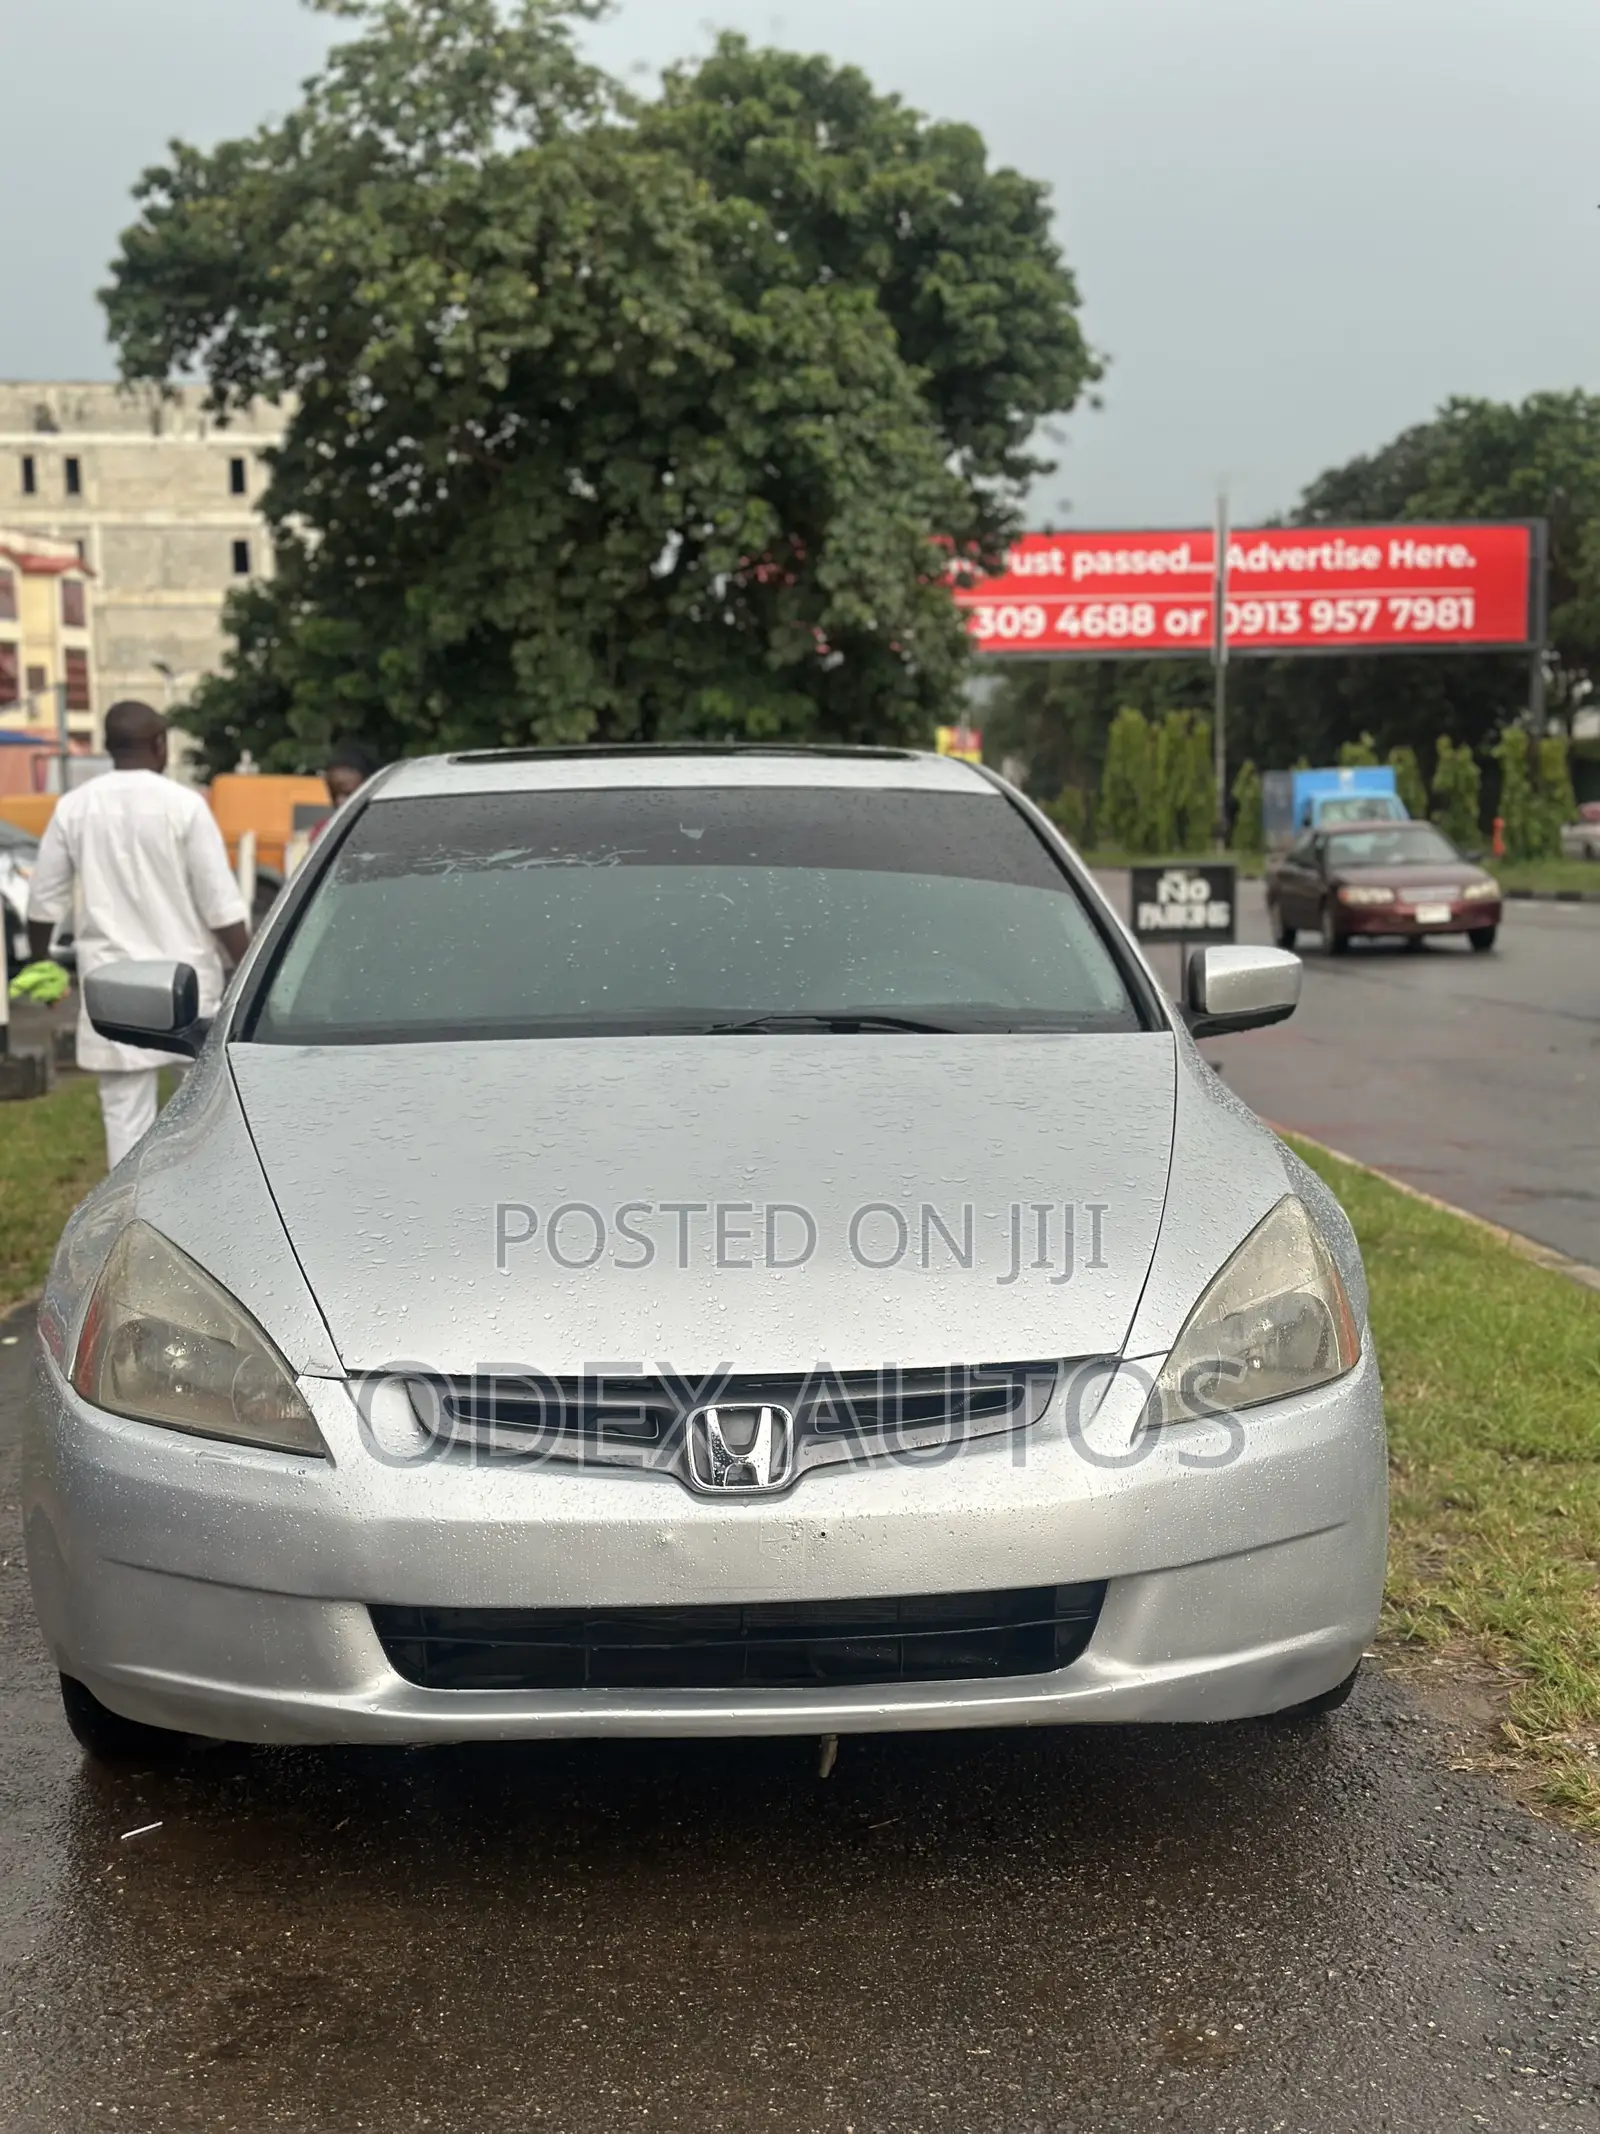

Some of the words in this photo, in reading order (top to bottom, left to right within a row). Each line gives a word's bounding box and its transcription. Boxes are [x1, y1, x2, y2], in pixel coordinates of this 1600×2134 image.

[1002, 546, 1065, 577] ust
[1226, 537, 1382, 572] Advertise
[1388, 537, 1477, 570] Here.
[974, 604, 1047, 638] 309
[1055, 602, 1155, 637] 4688
[1164, 608, 1206, 635] or
[1222, 600, 1302, 634] 0913
[1309, 599, 1380, 633] 957
[1387, 596, 1476, 631] 7981
